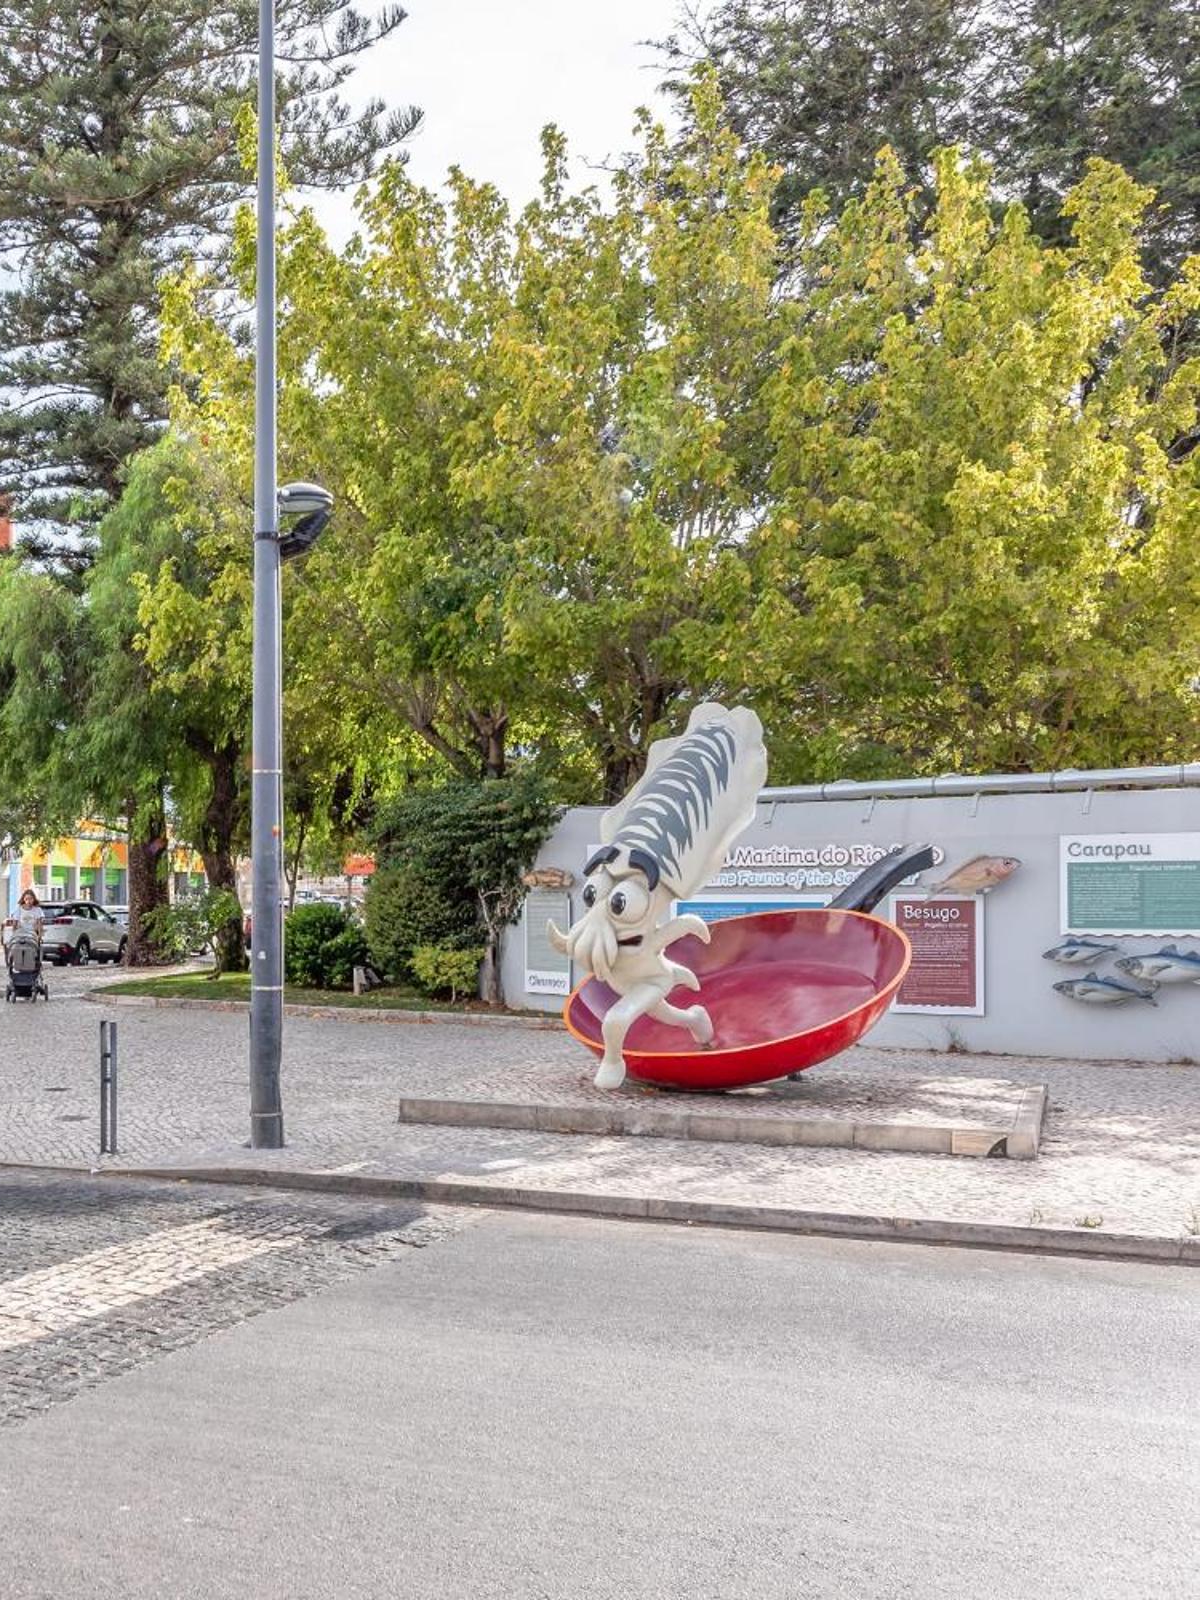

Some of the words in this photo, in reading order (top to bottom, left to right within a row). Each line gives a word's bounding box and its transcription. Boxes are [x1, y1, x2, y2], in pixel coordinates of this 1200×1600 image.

[820, 845, 848, 865] do
[853, 846, 885, 864] Rio
[1067, 842, 1152, 860] Carapau
[740, 871, 784, 885] Fauna
[788, 870, 805, 888] of
[808, 869, 833, 885] the
[903, 905, 960, 922] Besugo
